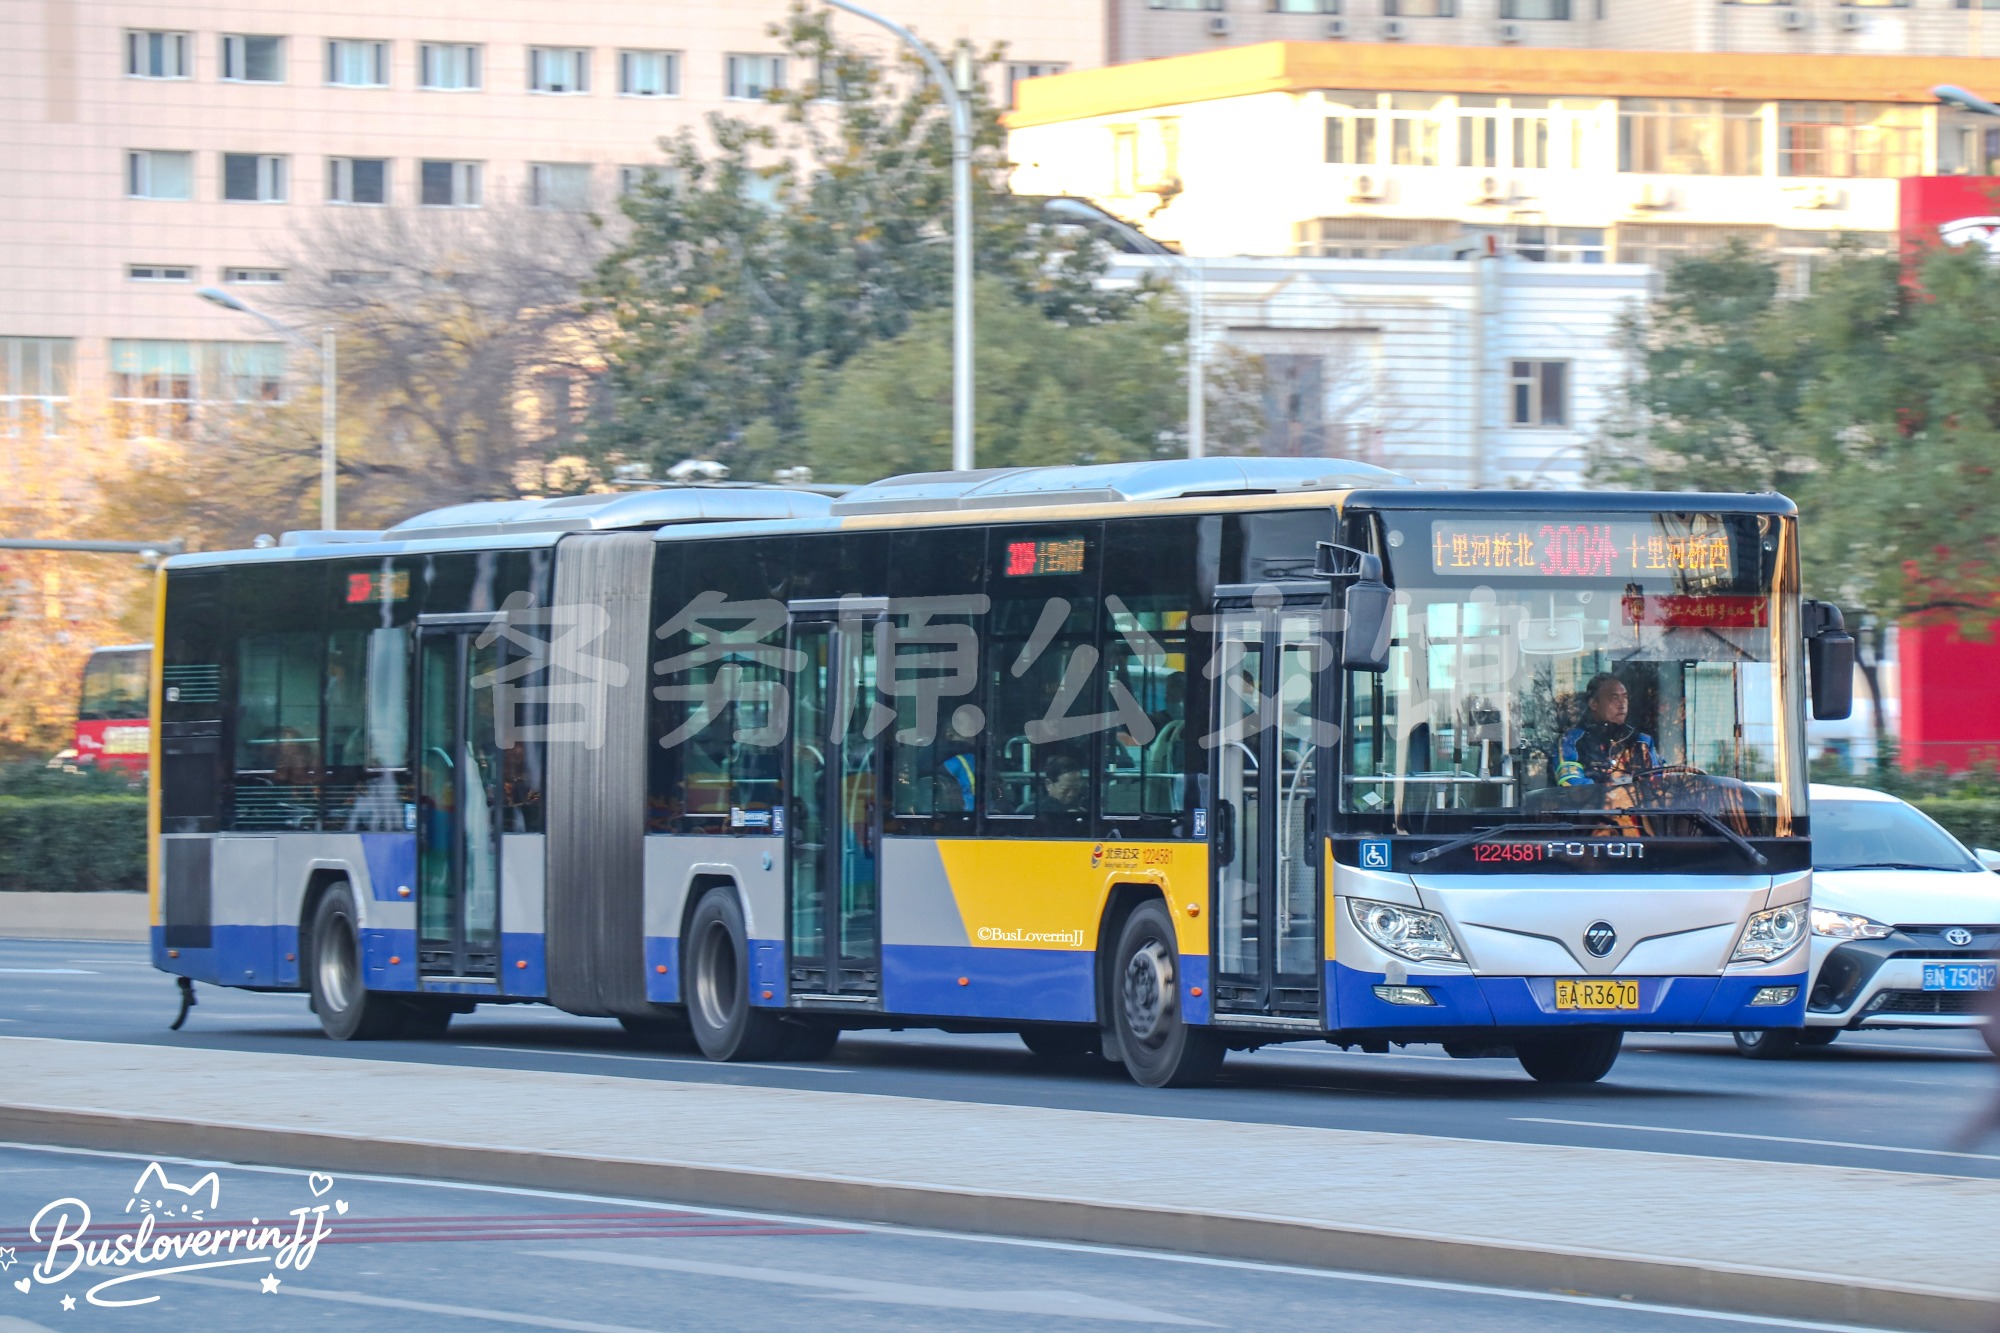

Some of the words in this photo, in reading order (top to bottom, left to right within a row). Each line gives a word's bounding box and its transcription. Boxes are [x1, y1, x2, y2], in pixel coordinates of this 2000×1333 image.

[1432, 531, 1536, 567] 十里河桥北
[1625, 533, 1729, 569] 十里河桥西
[1105, 847, 1140, 860] 北京公交
[1143, 848, 1173, 865] 1224581
[1472, 844, 1542, 861] 1224581
[1547, 842, 1644, 858] FOTON
